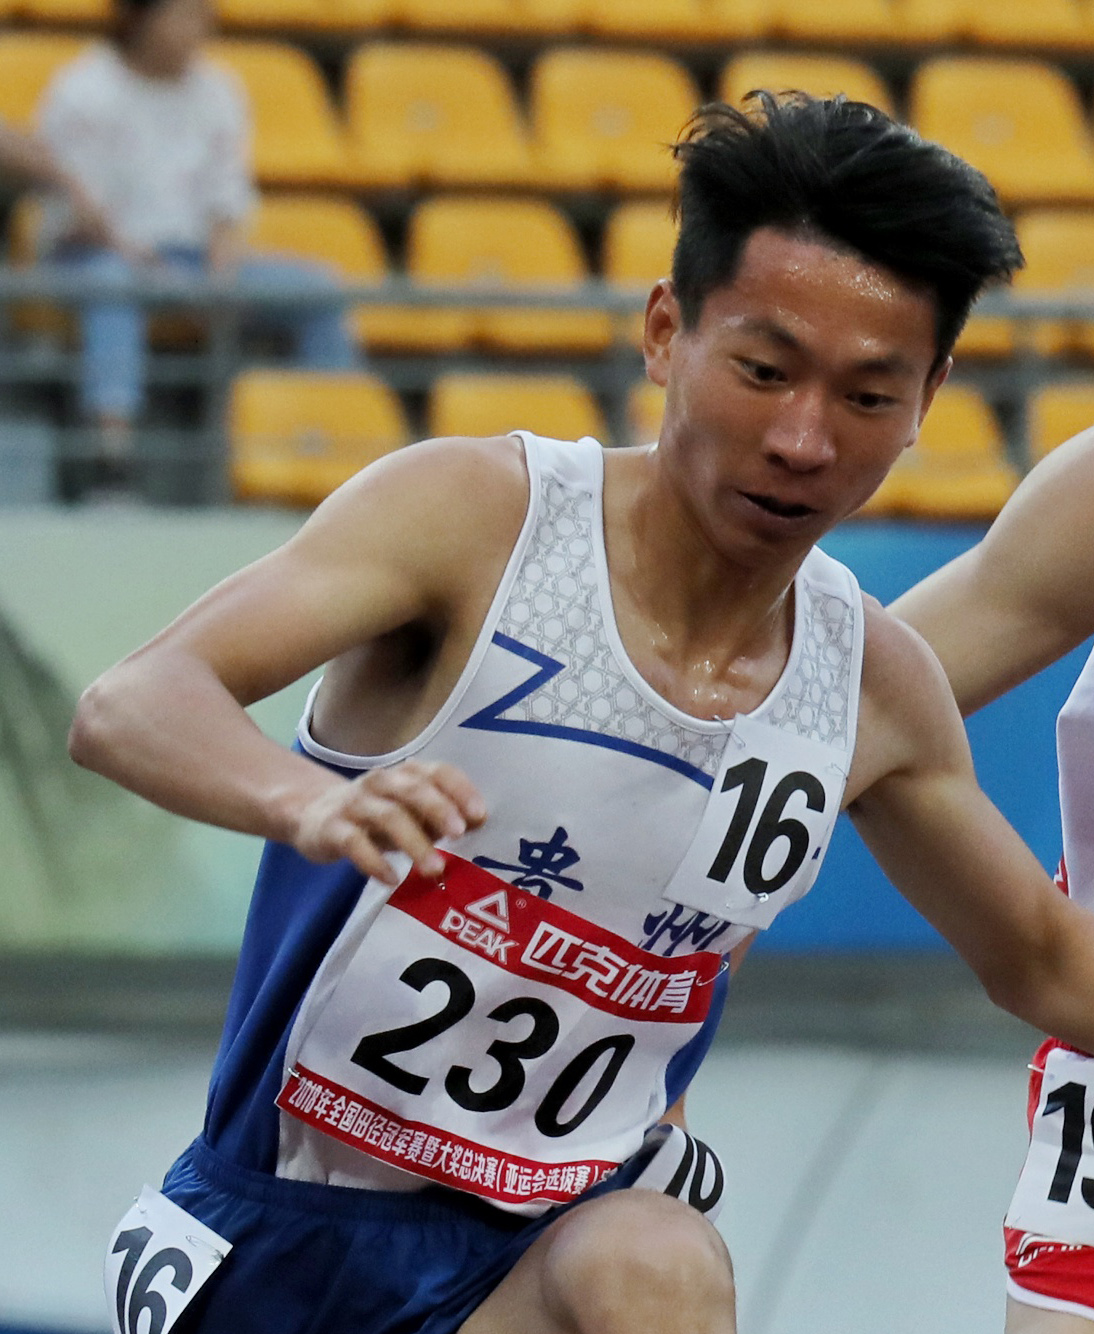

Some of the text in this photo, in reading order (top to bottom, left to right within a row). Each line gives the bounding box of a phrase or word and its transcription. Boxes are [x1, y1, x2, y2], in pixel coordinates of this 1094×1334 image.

[706, 757, 826, 896] 16
[439, 907, 519, 965] PEAK
[520, 921, 697, 1014] 匹克体育
[350, 957, 636, 1137] 230
